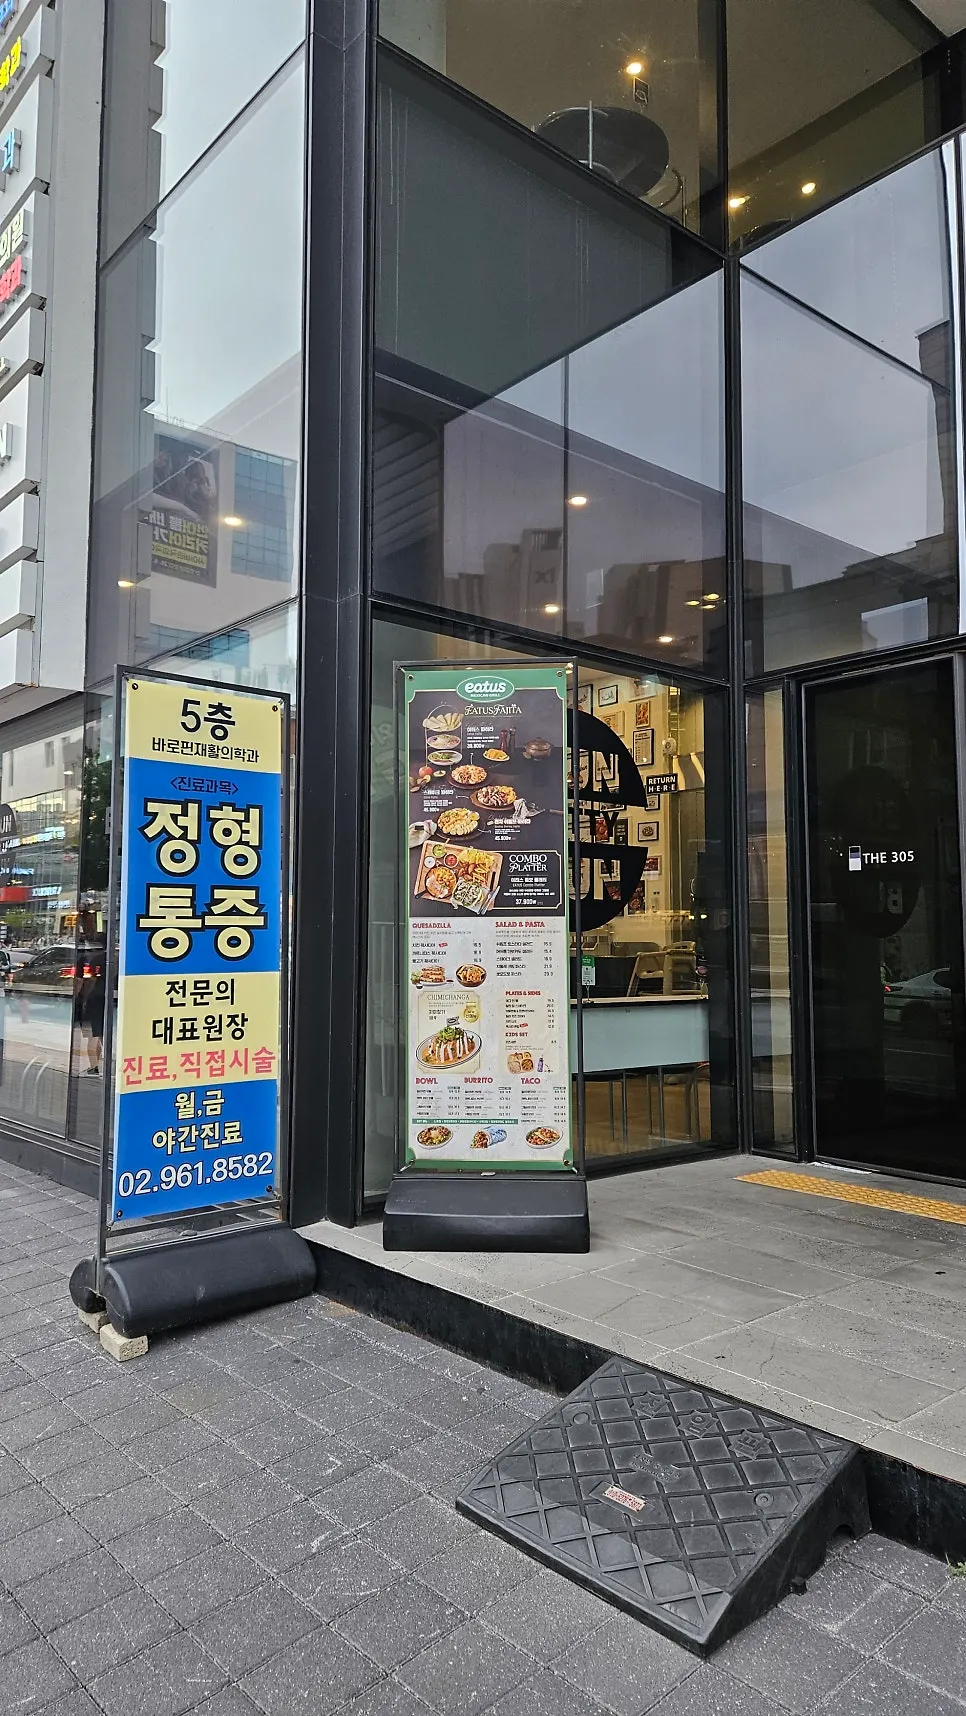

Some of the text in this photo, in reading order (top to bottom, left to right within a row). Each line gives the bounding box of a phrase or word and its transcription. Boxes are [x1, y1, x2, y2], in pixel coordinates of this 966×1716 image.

[464, 680, 507, 694] eatus
[181, 698, 236, 742] 5층
[648, 775, 676, 785] RETURN
[137, 797, 264, 880] 정형
[509, 854, 547, 863] COMBO
[509, 862, 547, 873] PLATTER
[862, 850, 915, 864] THE 305
[135, 882, 269, 962] 통증
[165, 978, 236, 1008] 전문의
[151, 1012, 248, 1045] 대표원장
[122, 1046, 277, 1086] 진료,직접시술
[415, 1077, 438, 1085] BOWL
[174, 1089, 226, 1120] 월,금
[151, 1120, 244, 1156] 야간진료
[117, 1151, 275, 1198] 02.961.8582
